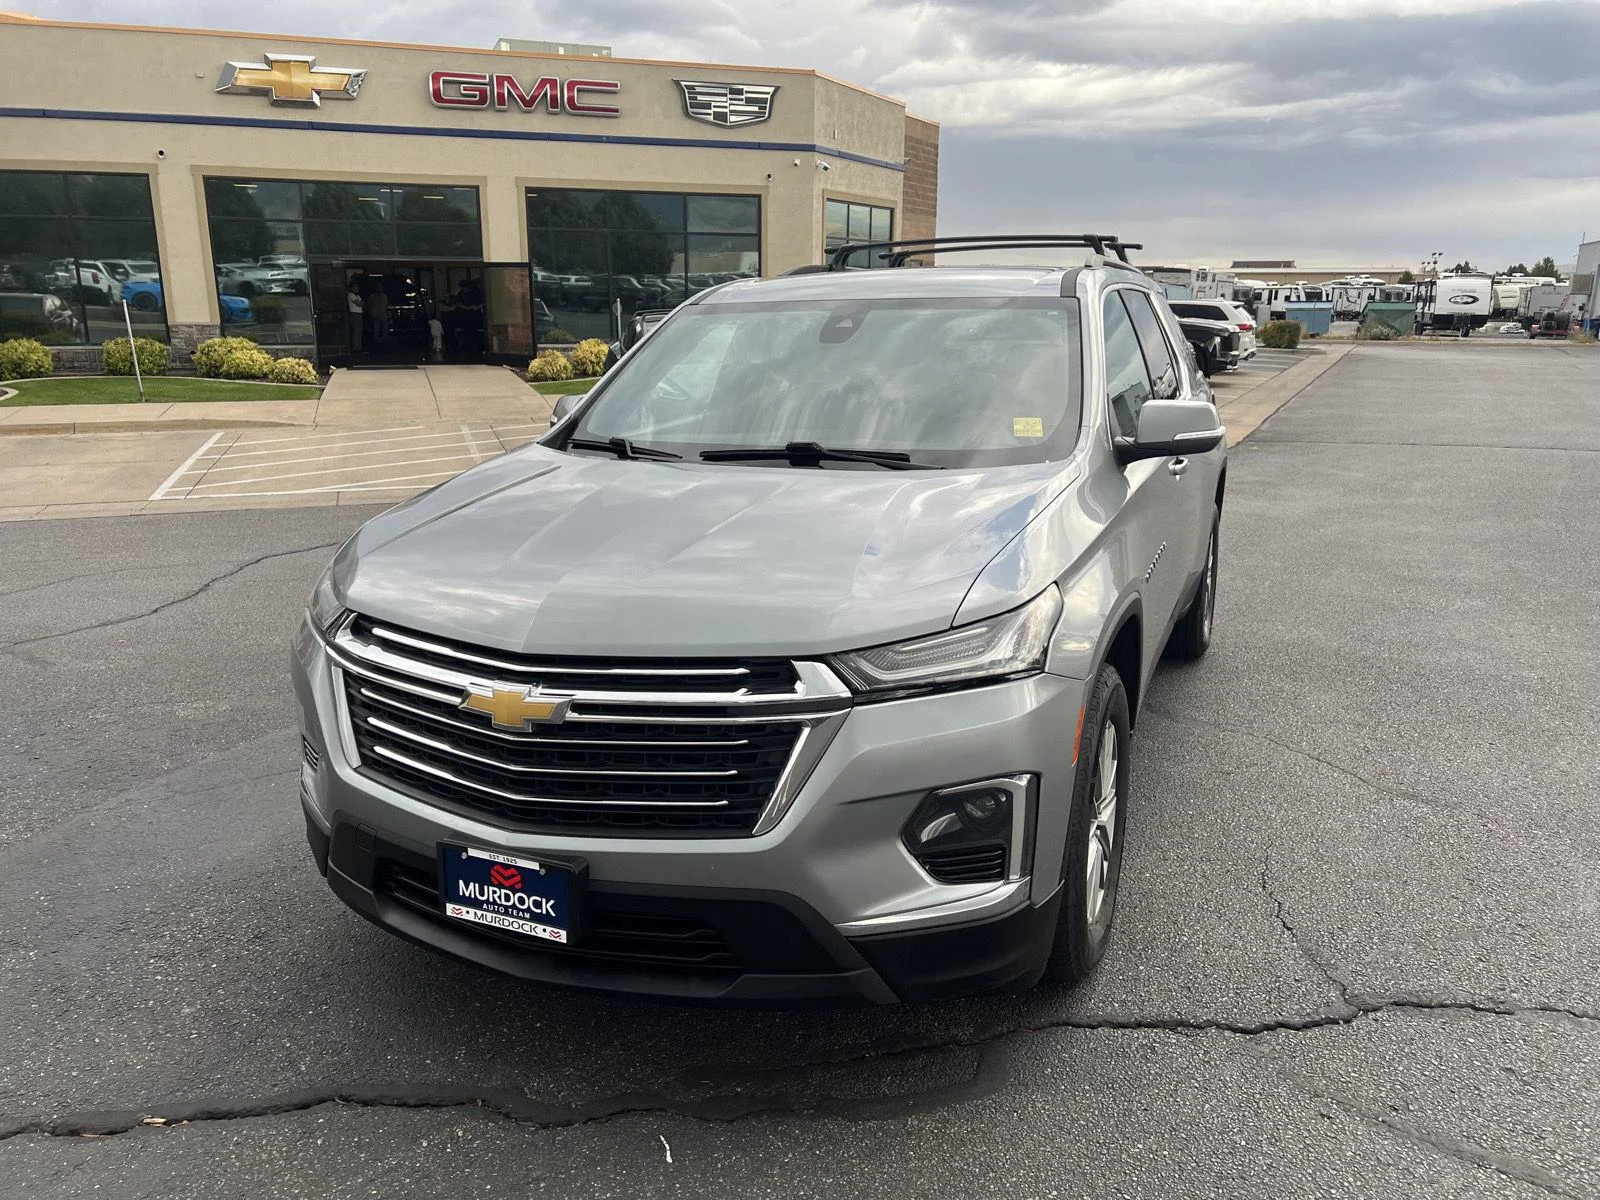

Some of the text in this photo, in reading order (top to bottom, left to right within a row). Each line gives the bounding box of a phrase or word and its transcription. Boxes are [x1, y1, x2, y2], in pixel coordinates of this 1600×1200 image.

[429, 70, 621, 117] GMC
[502, 856, 518, 865] 1925
[458, 879, 556, 917] MURDOCK
[473, 911, 539, 935] MURDOCK
[482, 903, 531, 919] AUTO TEAM
